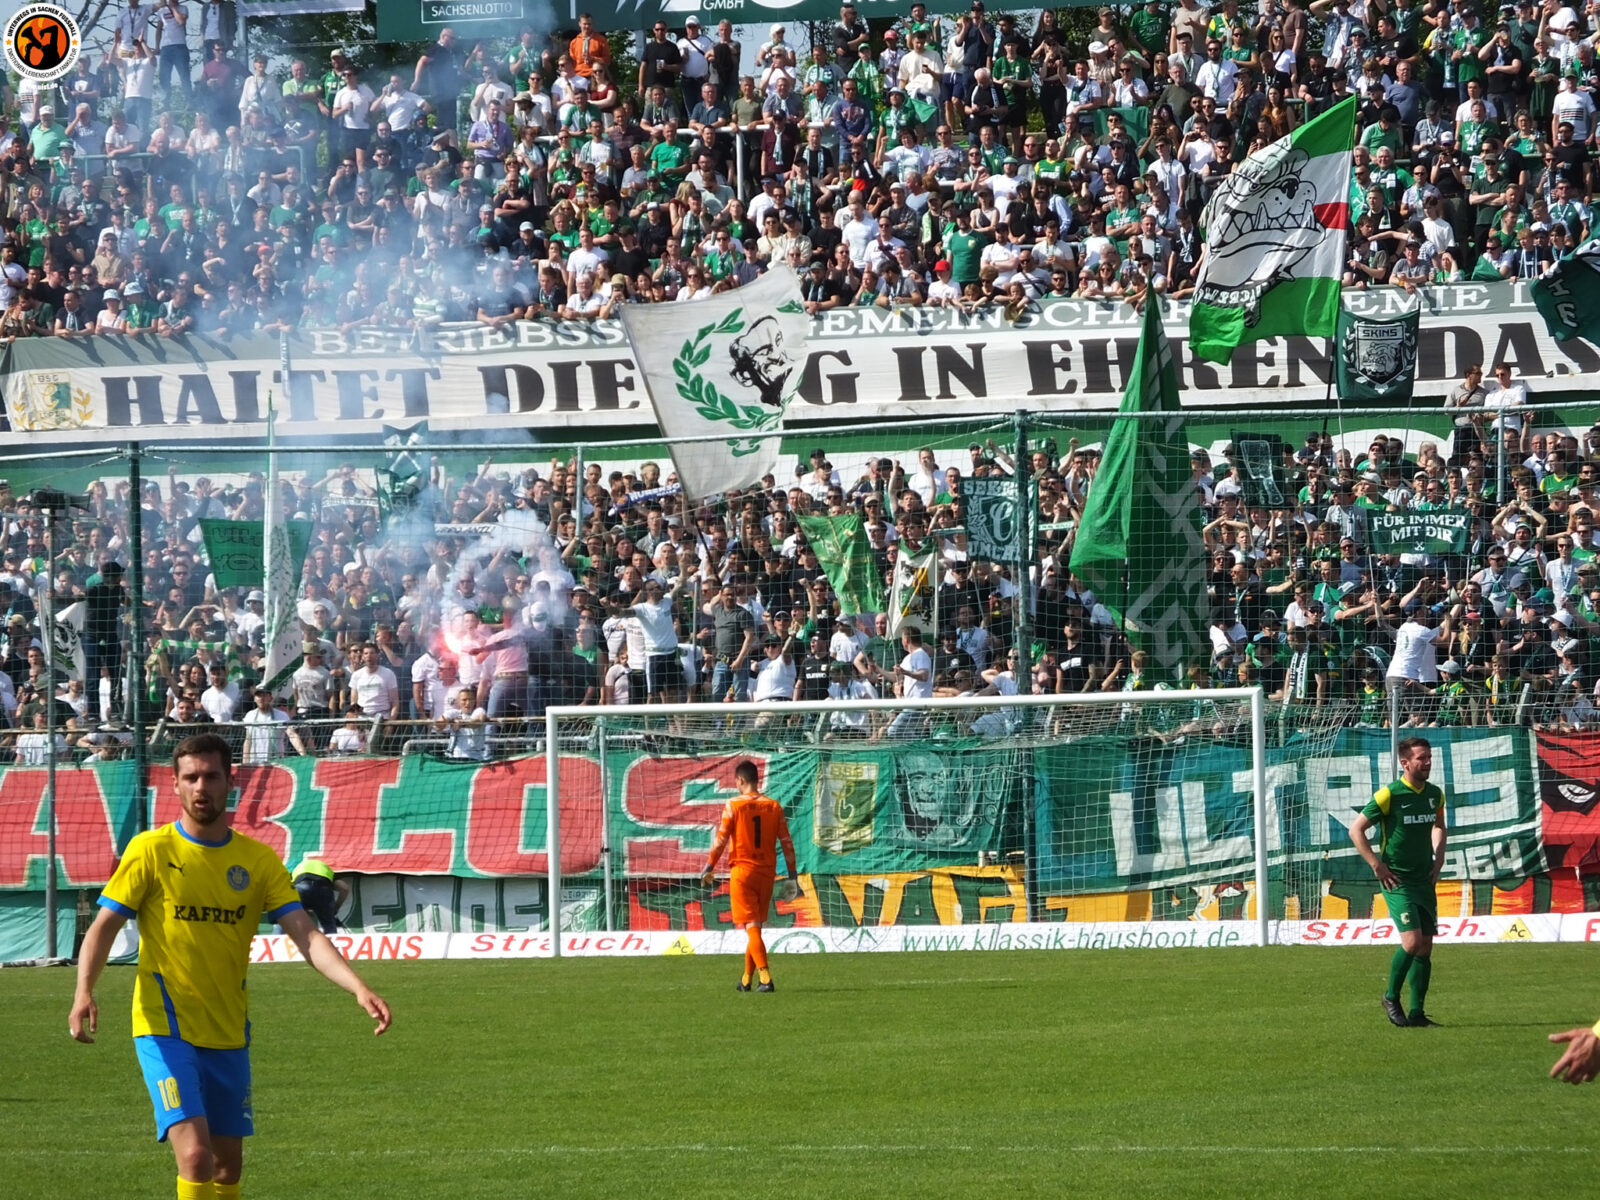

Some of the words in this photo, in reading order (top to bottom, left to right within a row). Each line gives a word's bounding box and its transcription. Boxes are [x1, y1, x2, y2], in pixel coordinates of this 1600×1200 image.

[431, 3, 513, 17] SACHSENLOTTO
[1363, 328, 1398, 338] SKINS
[101, 368, 441, 427] HALTET
[477, 358, 641, 414] DIE
[891, 342, 988, 401] IN
[1022, 336, 1334, 397] EHREN
[1373, 513, 1405, 531] FÜR
[1409, 514, 1467, 529] IMMER
[1391, 525, 1422, 544] MIT
[1425, 525, 1453, 543] DIR
[752, 815, 761, 848] 1
[904, 926, 1240, 951] www.klassik-hausboot.de
[1302, 918, 1487, 941] Strach.
[157, 1076, 181, 1111] 18
